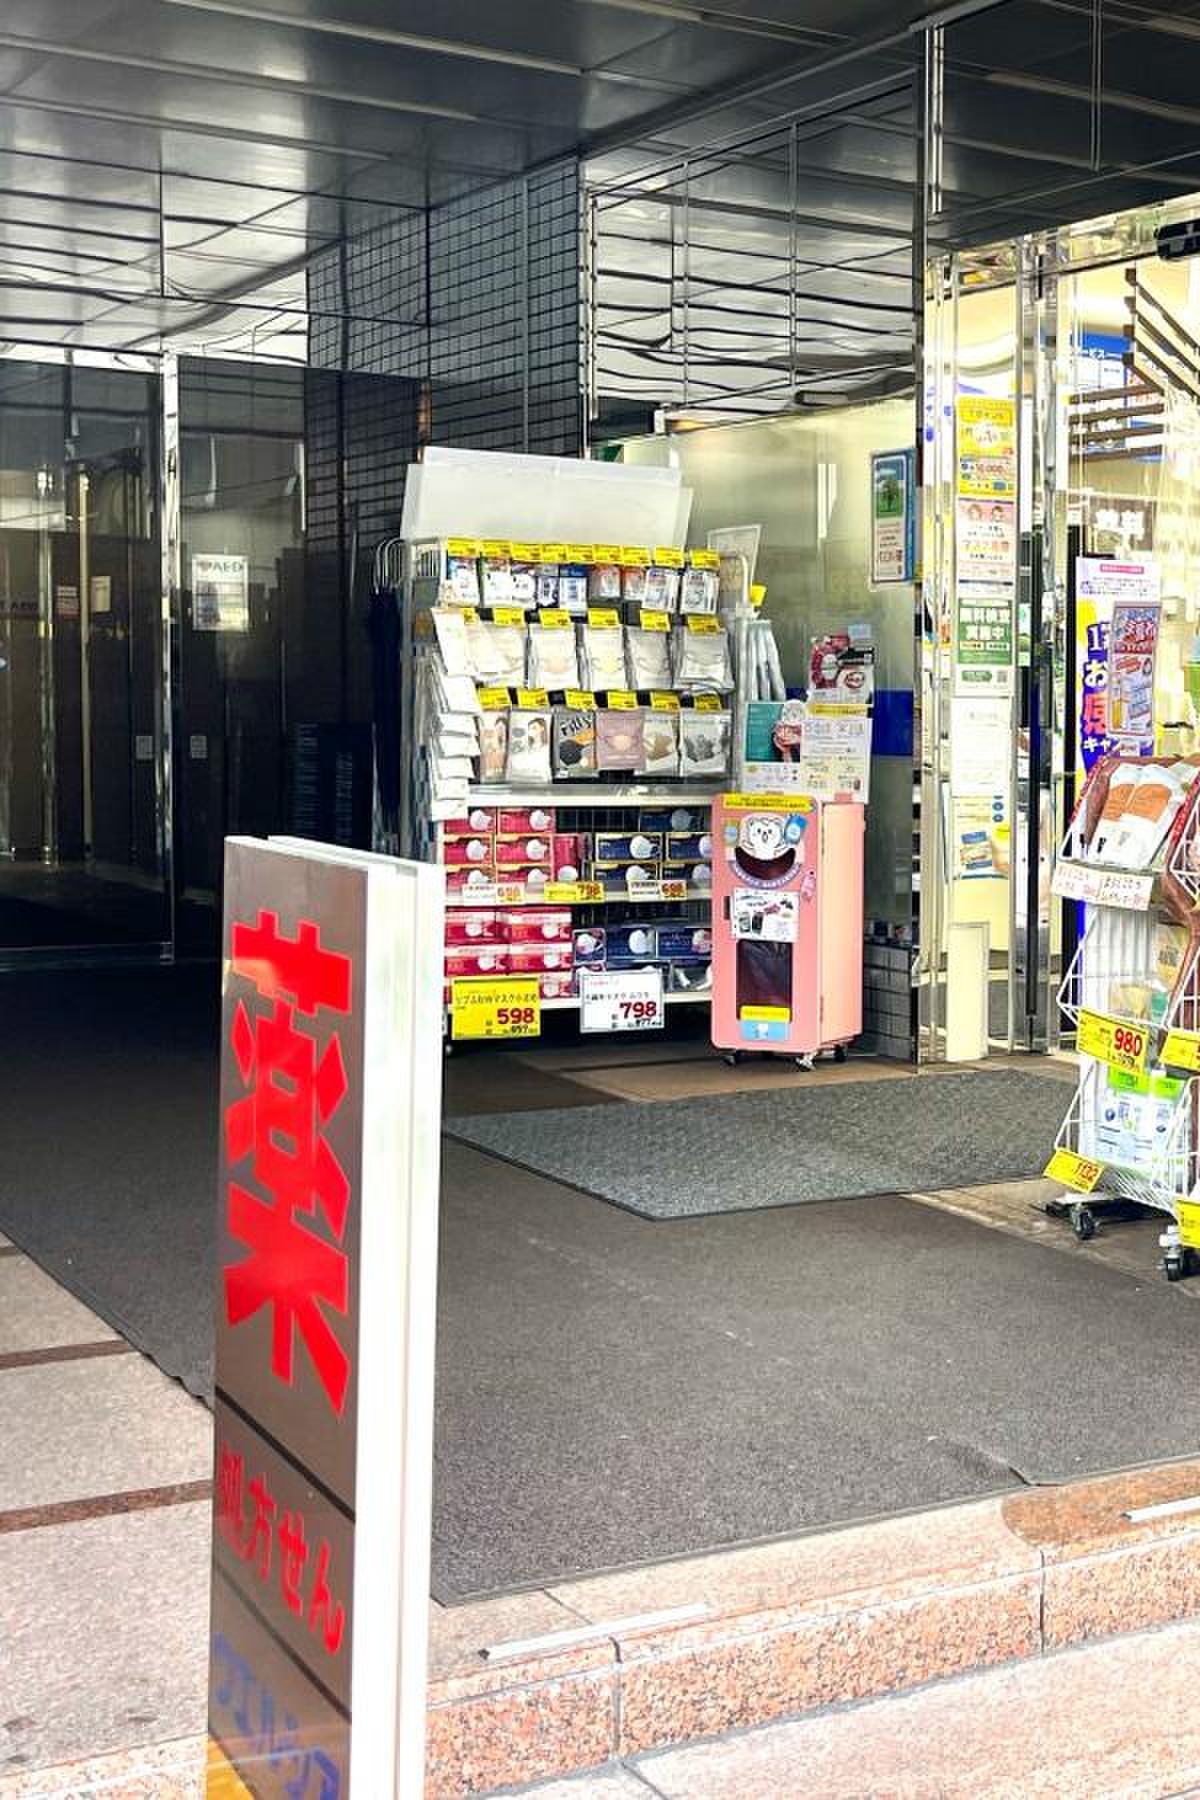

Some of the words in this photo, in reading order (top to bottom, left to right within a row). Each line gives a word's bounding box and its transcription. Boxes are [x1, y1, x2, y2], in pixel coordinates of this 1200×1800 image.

[497, 1008, 534, 1025] 598
[620, 1001, 657, 1019] 798
[1114, 1028, 1143, 1057] 980
[224, 908, 352, 1421] 薬
